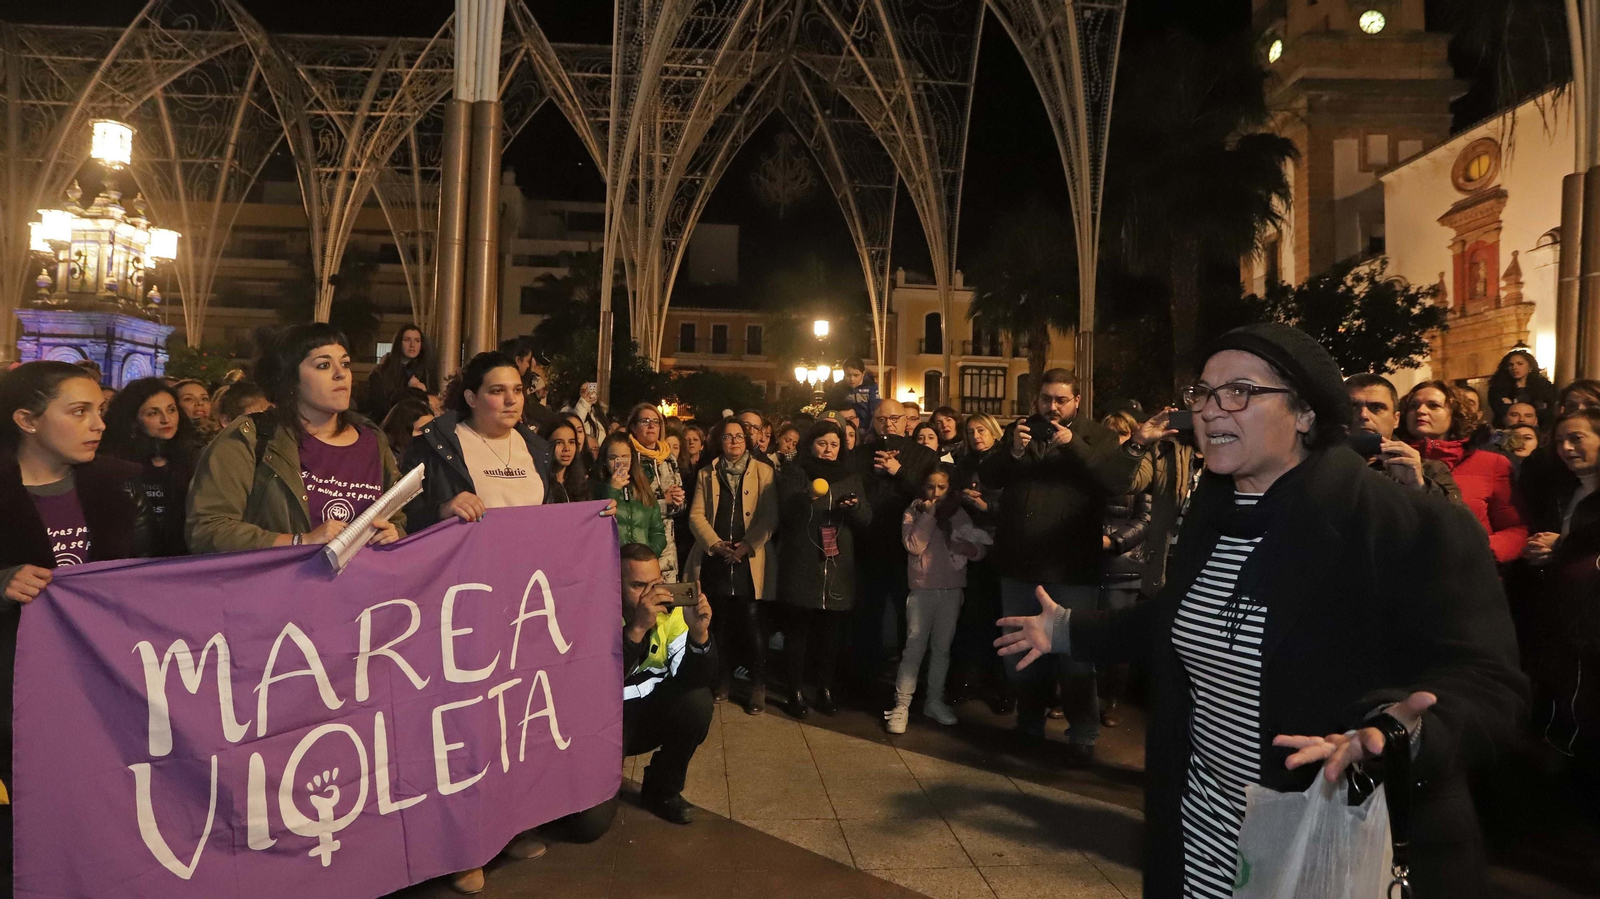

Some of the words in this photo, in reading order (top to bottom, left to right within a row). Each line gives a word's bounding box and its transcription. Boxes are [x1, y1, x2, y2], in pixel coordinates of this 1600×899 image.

[312, 475, 347, 487] nosotras
[318, 487, 343, 497] mundo
[346, 491, 356, 499] se
[70, 540, 84, 549] se
[132, 570, 573, 757] MAREA
[128, 670, 572, 880] VIOLETA
